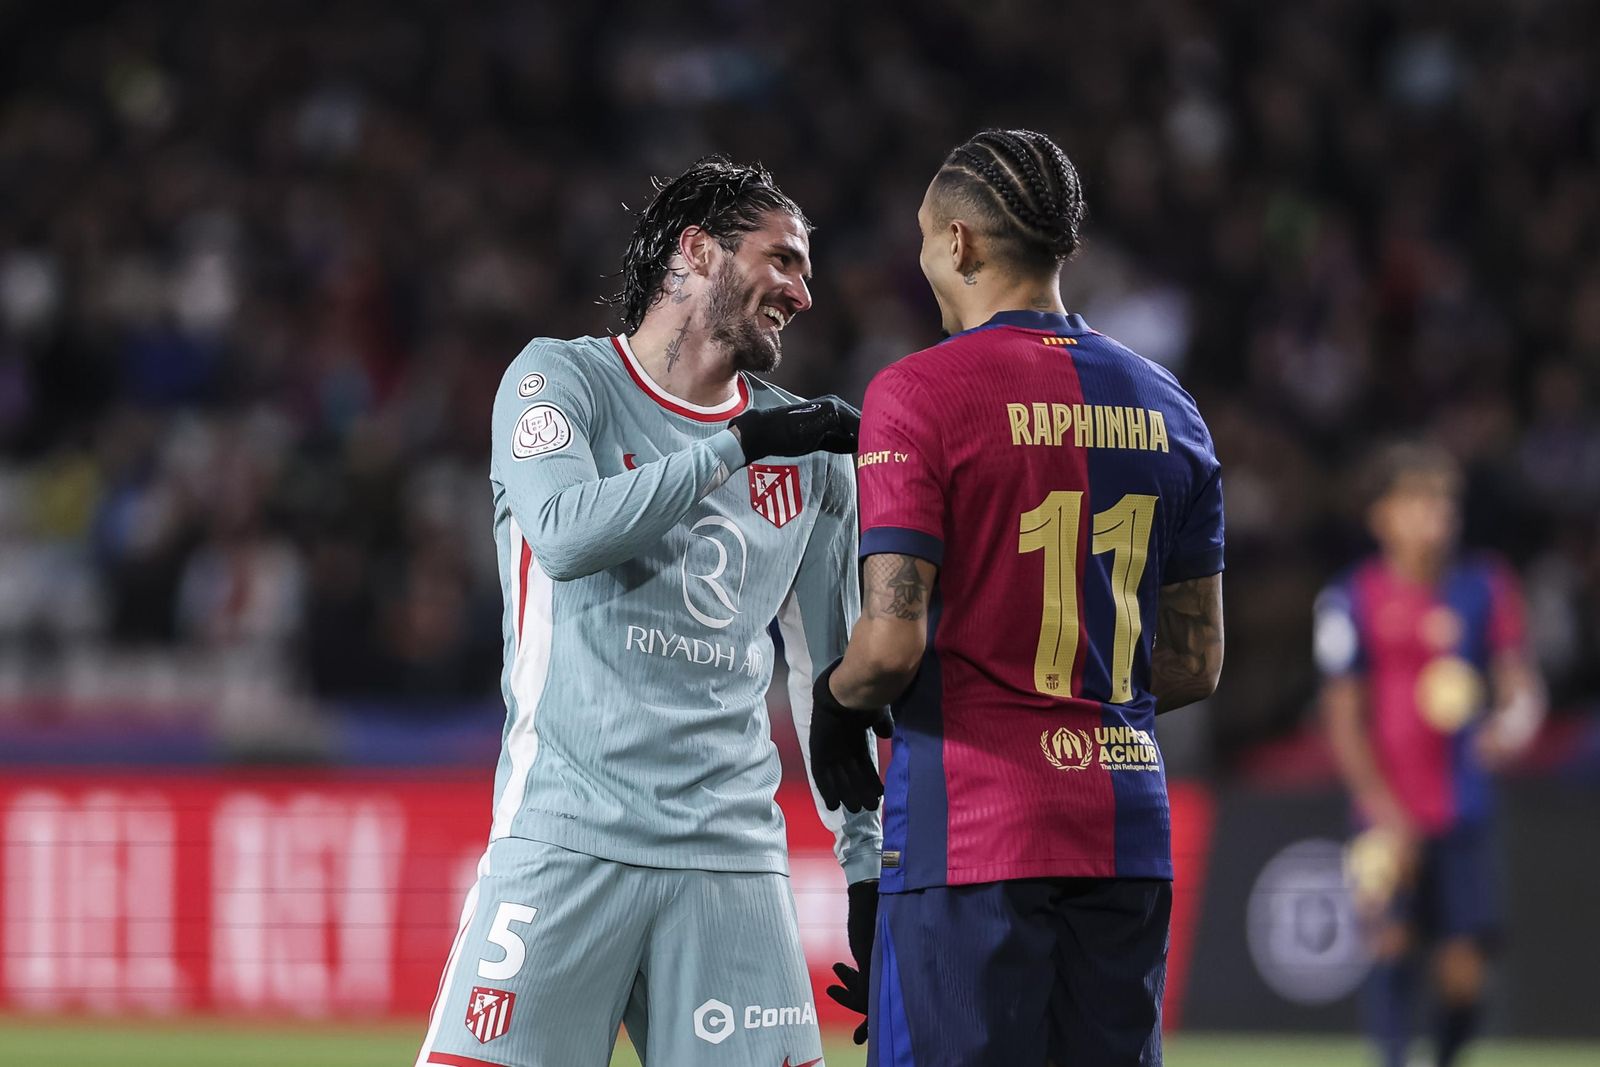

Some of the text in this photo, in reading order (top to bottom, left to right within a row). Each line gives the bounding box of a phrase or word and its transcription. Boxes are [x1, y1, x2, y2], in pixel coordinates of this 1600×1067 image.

[523, 379, 540, 391] 10
[1006, 402, 1169, 453] RAPHINHA
[893, 451, 909, 463] tv
[1018, 491, 1159, 704] 11
[625, 625, 735, 671] RIYADH
[1098, 745, 1159, 763] ACNUR
[477, 900, 538, 981] 5
